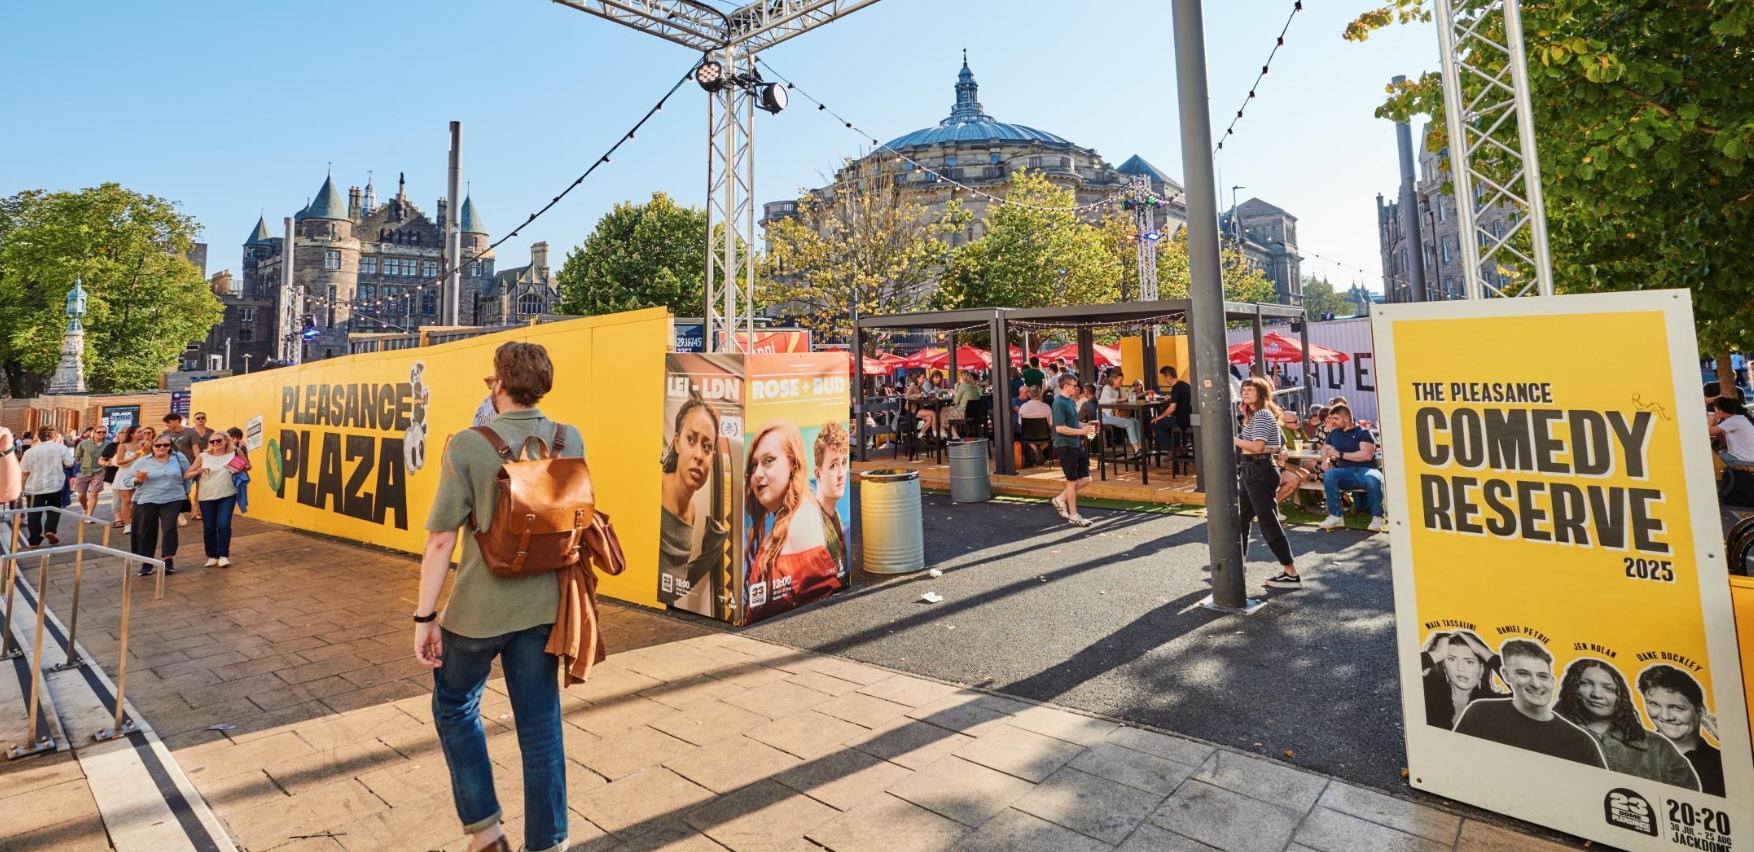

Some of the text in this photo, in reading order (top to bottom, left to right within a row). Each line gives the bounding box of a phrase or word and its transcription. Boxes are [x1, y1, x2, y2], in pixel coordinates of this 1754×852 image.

[667, 376, 690, 397] LEI
[702, 377, 740, 400] LDN
[752, 378, 800, 400] ROSE
[813, 376, 845, 396] BUD
[1412, 382, 1553, 403] THE PLEASANCE
[280, 382, 413, 432] PLEASANCE
[1415, 406, 1654, 479] COMEDY
[276, 429, 409, 531] PLAZA
[1420, 473, 1672, 555] RESERVE
[1623, 557, 1675, 582] 2025
[752, 586, 764, 597] 33
[772, 575, 792, 590] 13:00
[1425, 620, 1441, 630] MAIA
[1496, 625, 1552, 645] DANIEL PETRIE
[1574, 642, 1617, 659] JEN NOLAN
[1636, 651, 1703, 672] DANE BUCKLEY
[1610, 792, 1649, 816] 23
[1666, 799, 1731, 836] 20:20
[1670, 822, 1680, 831] 30
[1682, 826, 1695, 836] JUL
[1705, 832, 1715, 841] 25
[1717, 835, 1732, 846] AUG
